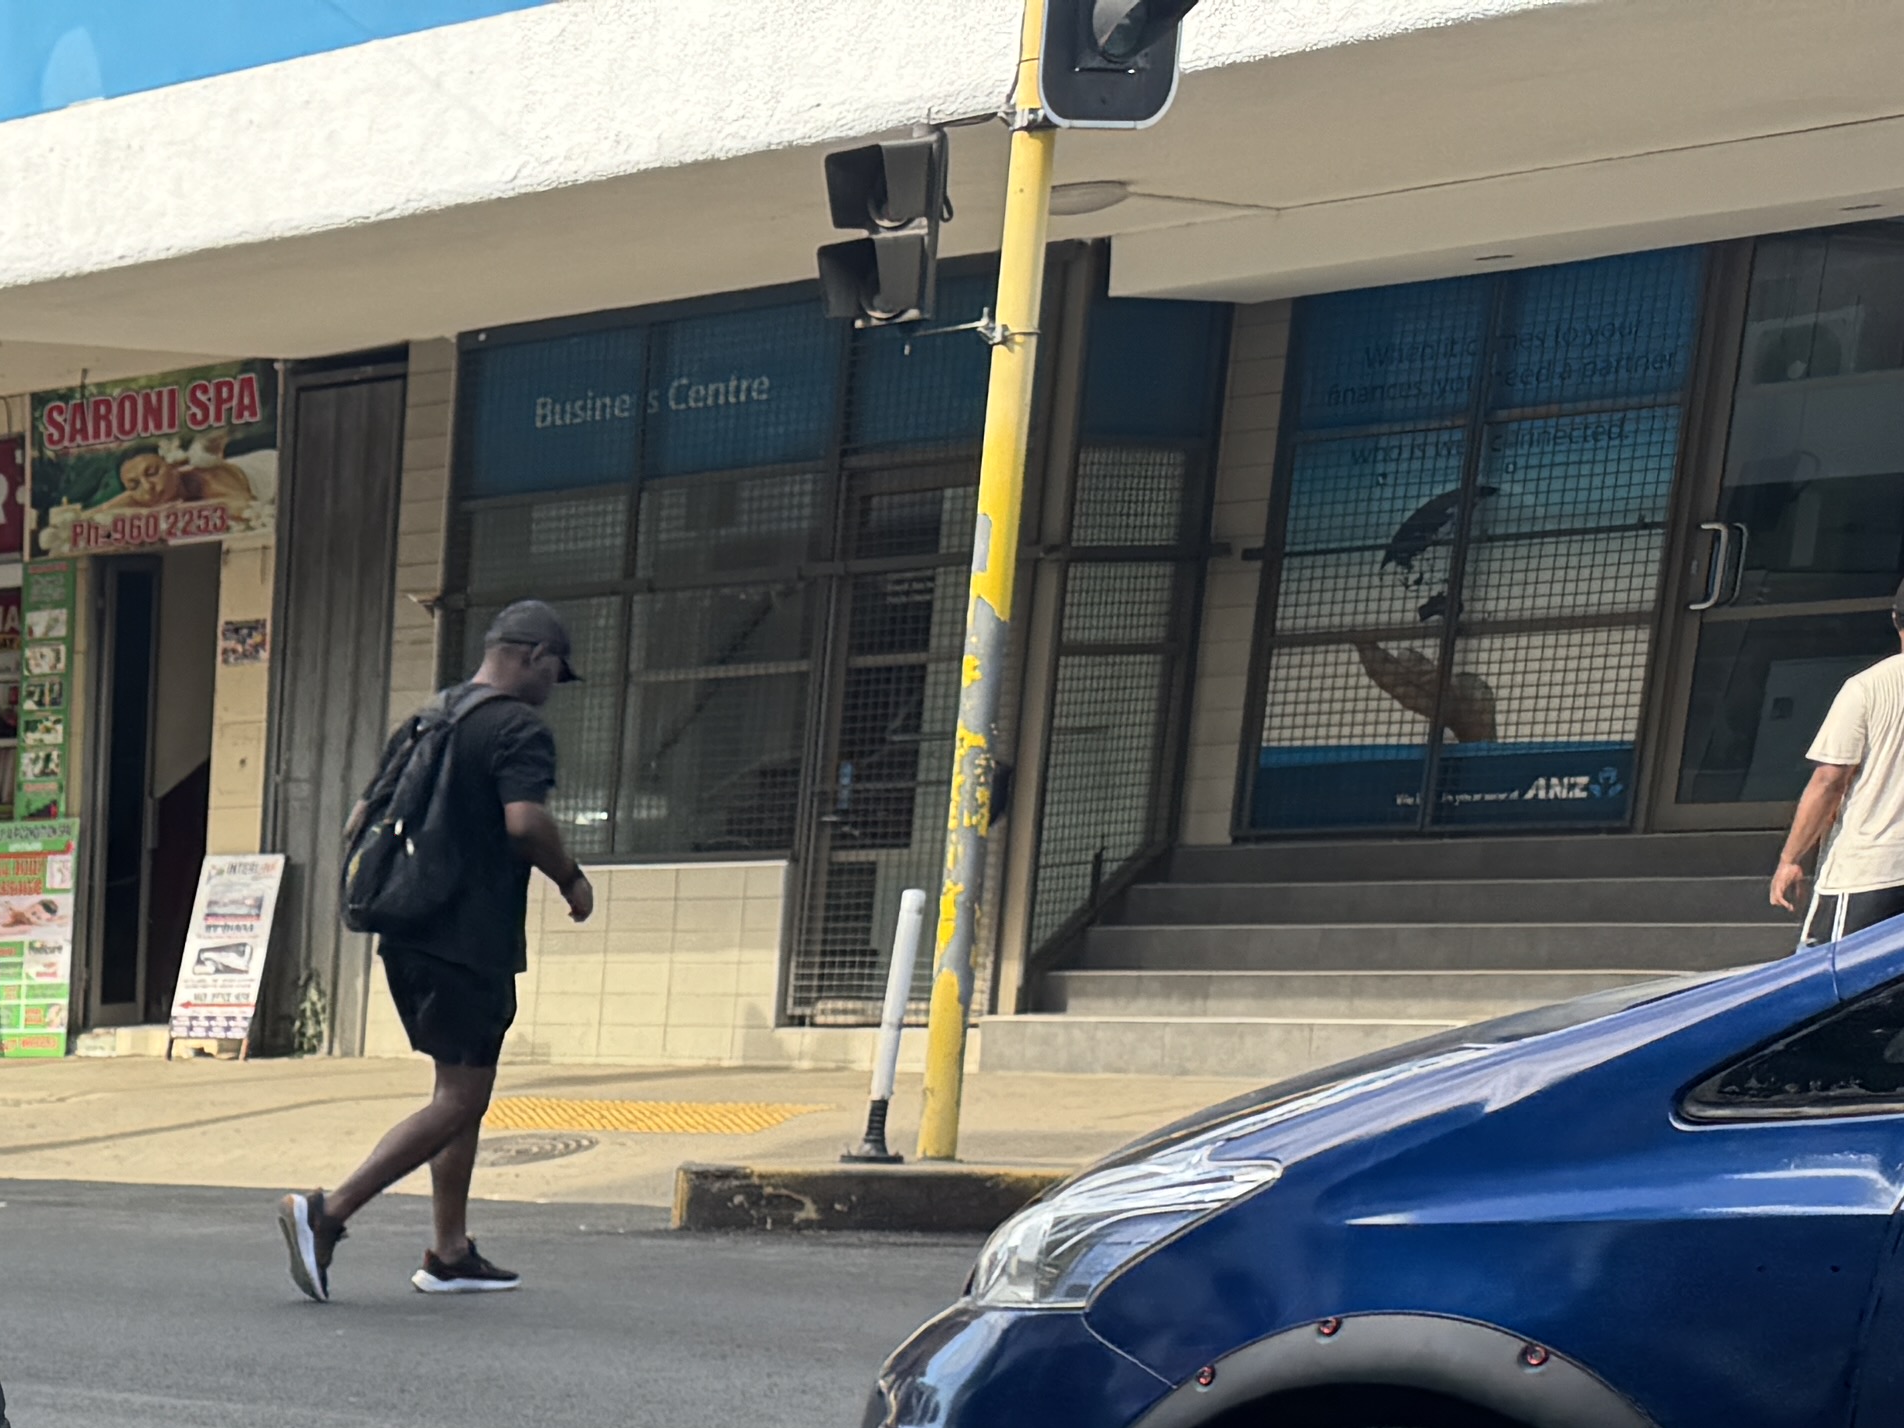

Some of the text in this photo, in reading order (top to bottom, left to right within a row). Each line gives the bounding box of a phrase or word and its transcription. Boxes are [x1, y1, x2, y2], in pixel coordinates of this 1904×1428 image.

[668, 372, 771, 411] Centre
[43, 373, 263, 450] SARONI SPA
[165, 505, 229, 540] 2253
[1523, 776, 1591, 801] ANZ
